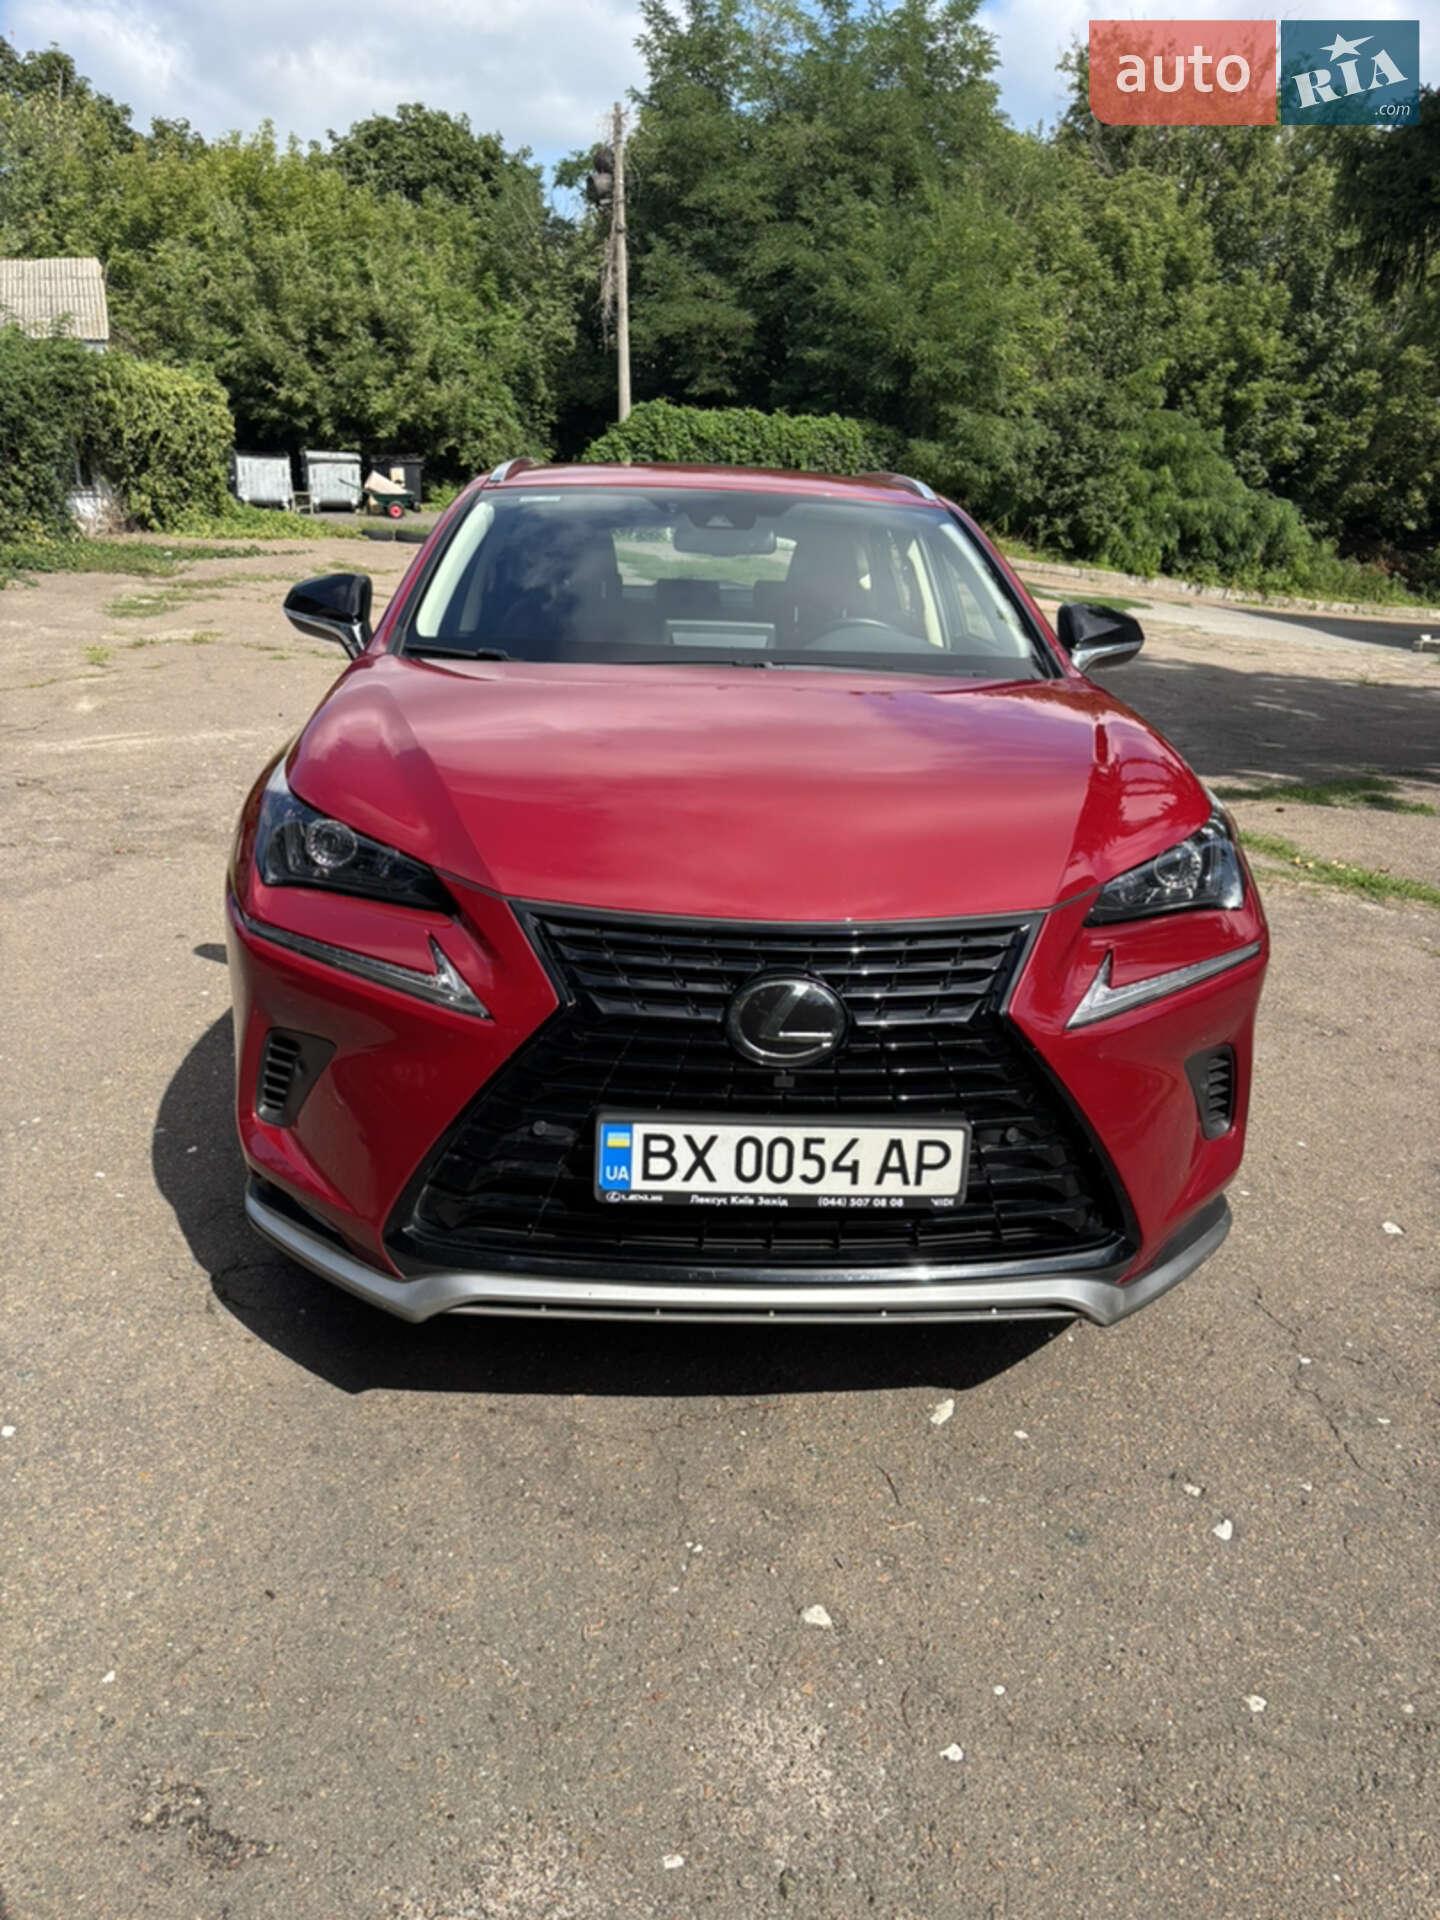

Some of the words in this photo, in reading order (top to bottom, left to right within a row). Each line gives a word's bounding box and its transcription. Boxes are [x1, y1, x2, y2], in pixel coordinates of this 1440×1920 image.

[641, 1133, 718, 1183] BX
[734, 1135, 861, 1186] 0054
[874, 1138, 952, 1187] AP
[605, 1165, 630, 1182] UA
[817, 1196, 847, 1207] (044)
[850, 1197, 871, 1207] 507
